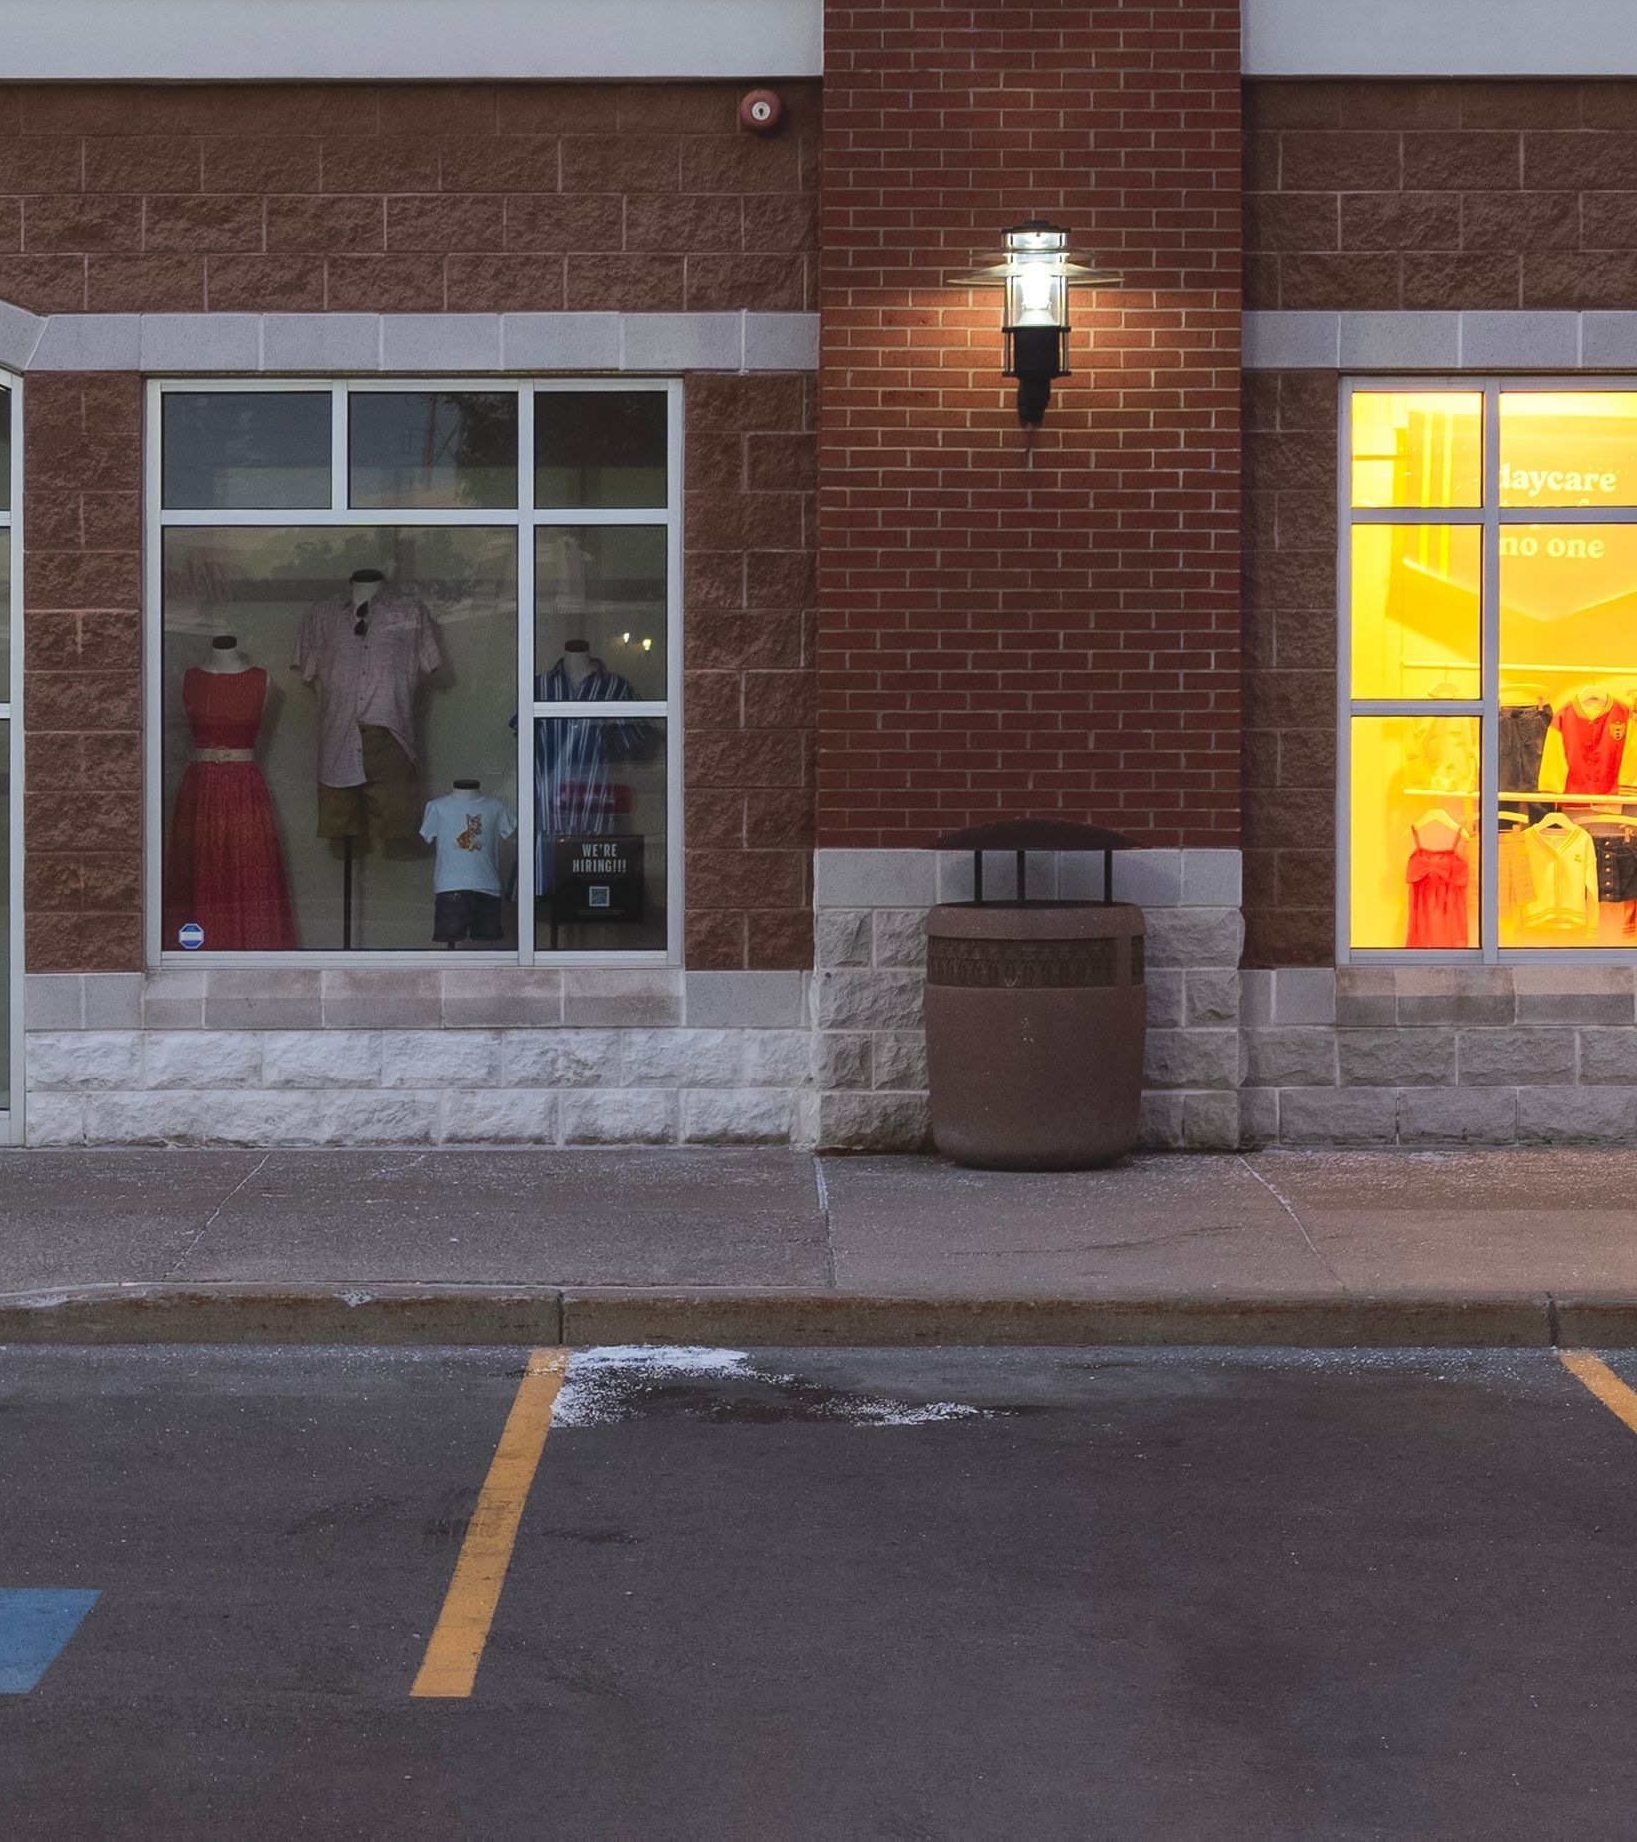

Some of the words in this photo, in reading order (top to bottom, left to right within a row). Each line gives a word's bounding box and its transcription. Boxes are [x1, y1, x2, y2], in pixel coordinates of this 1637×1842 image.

[1499, 535, 1538, 557] no
[1545, 537, 1605, 559] one
[582, 843, 618, 857] WE'RE
[572, 859, 627, 873] HIRING!!!
